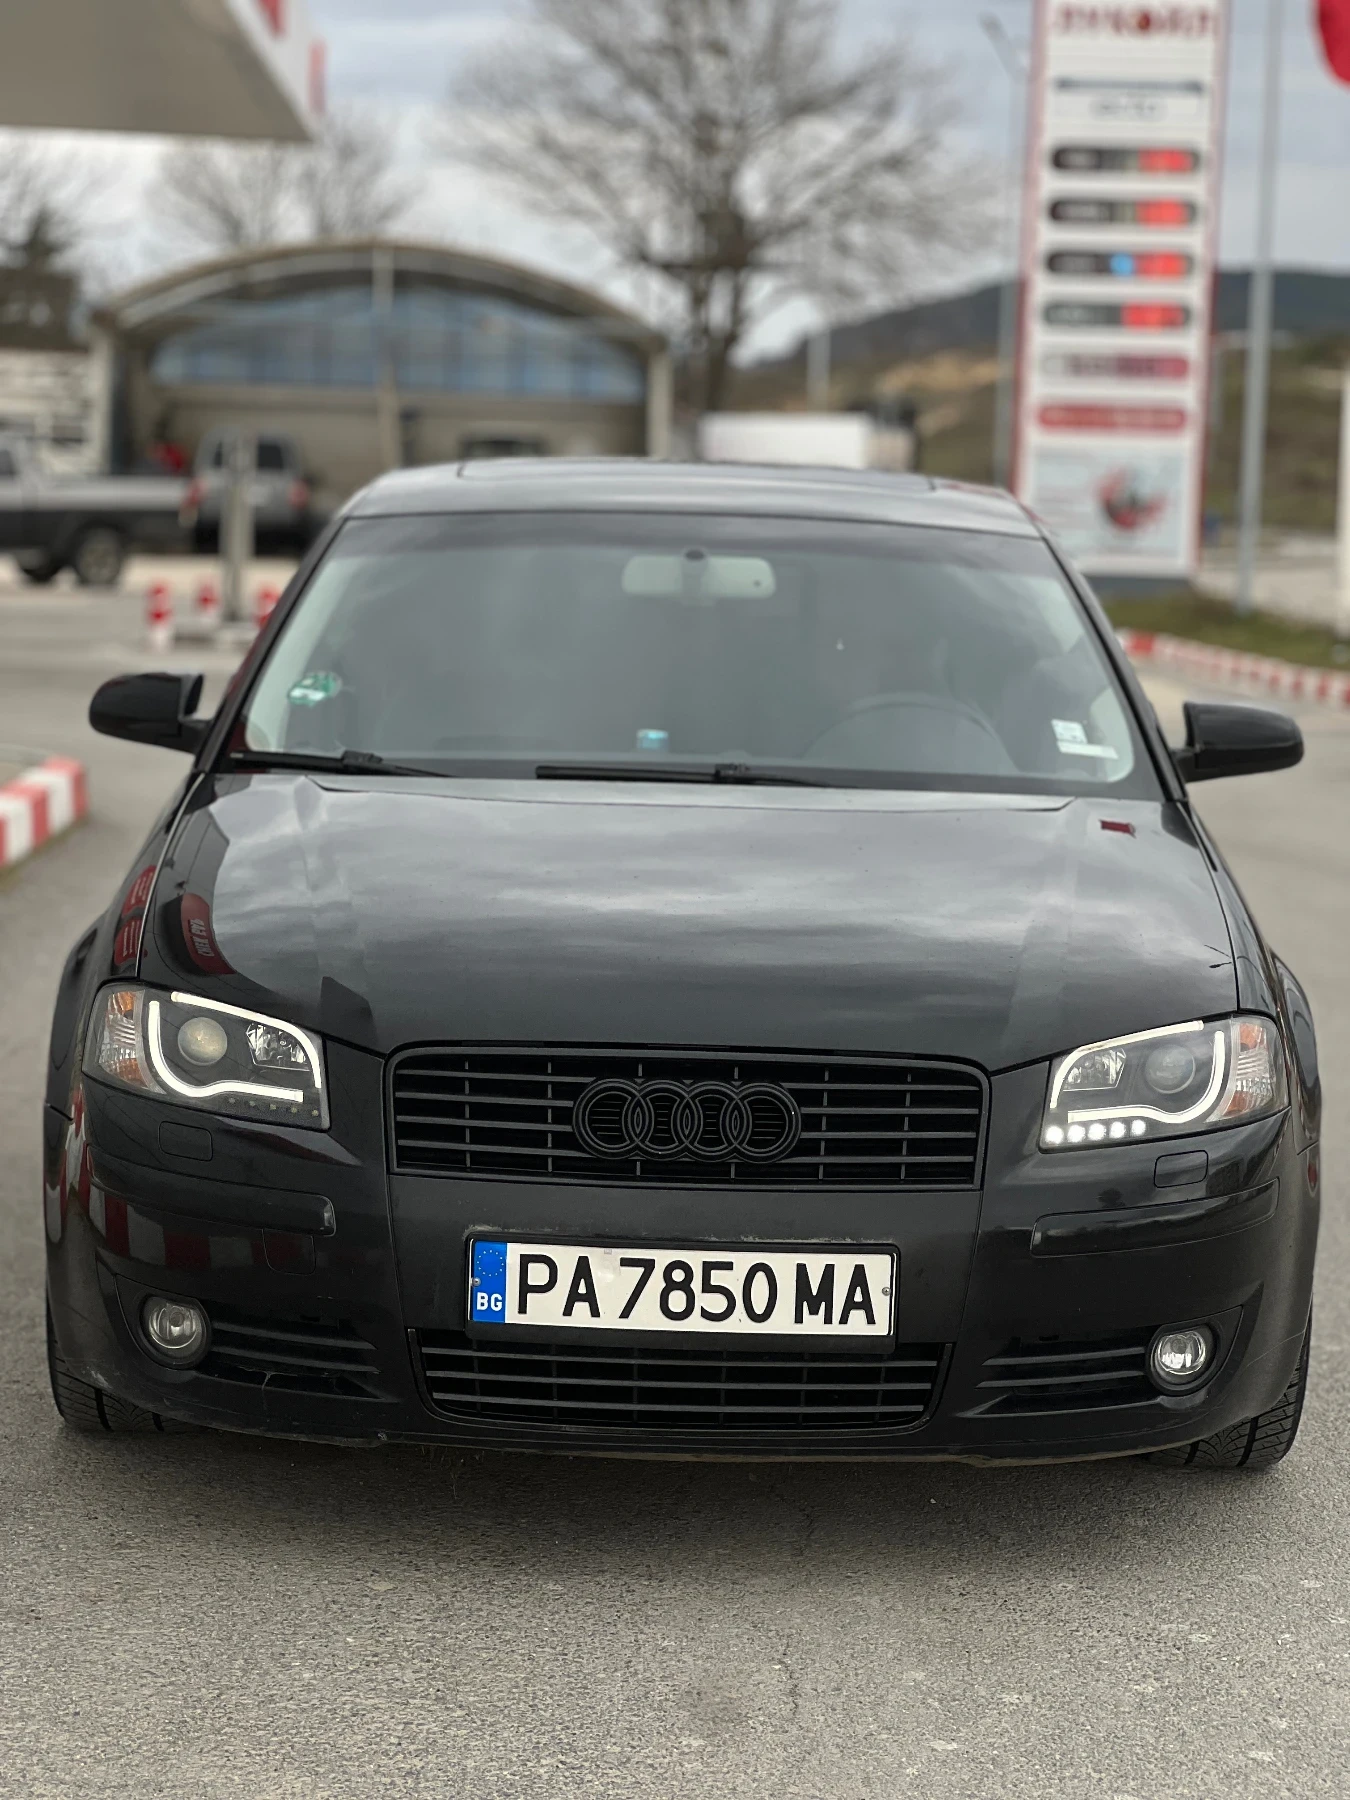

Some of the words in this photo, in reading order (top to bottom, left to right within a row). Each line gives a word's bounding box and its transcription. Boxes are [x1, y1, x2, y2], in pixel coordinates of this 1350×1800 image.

[476, 1292, 503, 1312] BG
[518, 1253, 601, 1318] PA
[618, 1256, 778, 1324] 7850
[794, 1262, 876, 1325] MA
